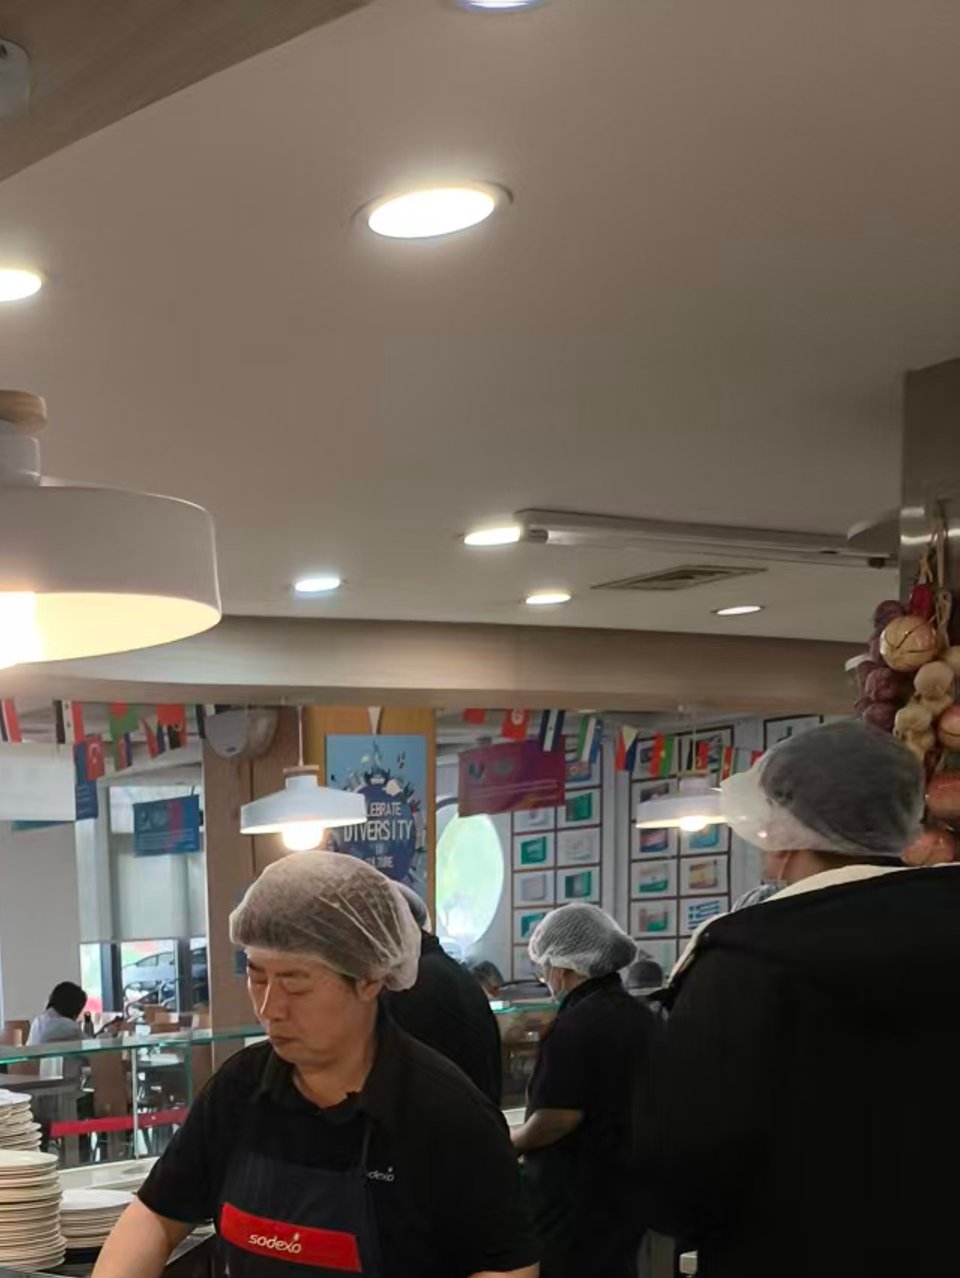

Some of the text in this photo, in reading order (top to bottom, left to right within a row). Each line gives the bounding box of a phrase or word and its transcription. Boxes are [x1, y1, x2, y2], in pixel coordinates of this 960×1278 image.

[367, 802, 402, 817] LEBRATE
[343, 819, 413, 842] DIVERSITY
[248, 1232, 302, 1254] sodexo
